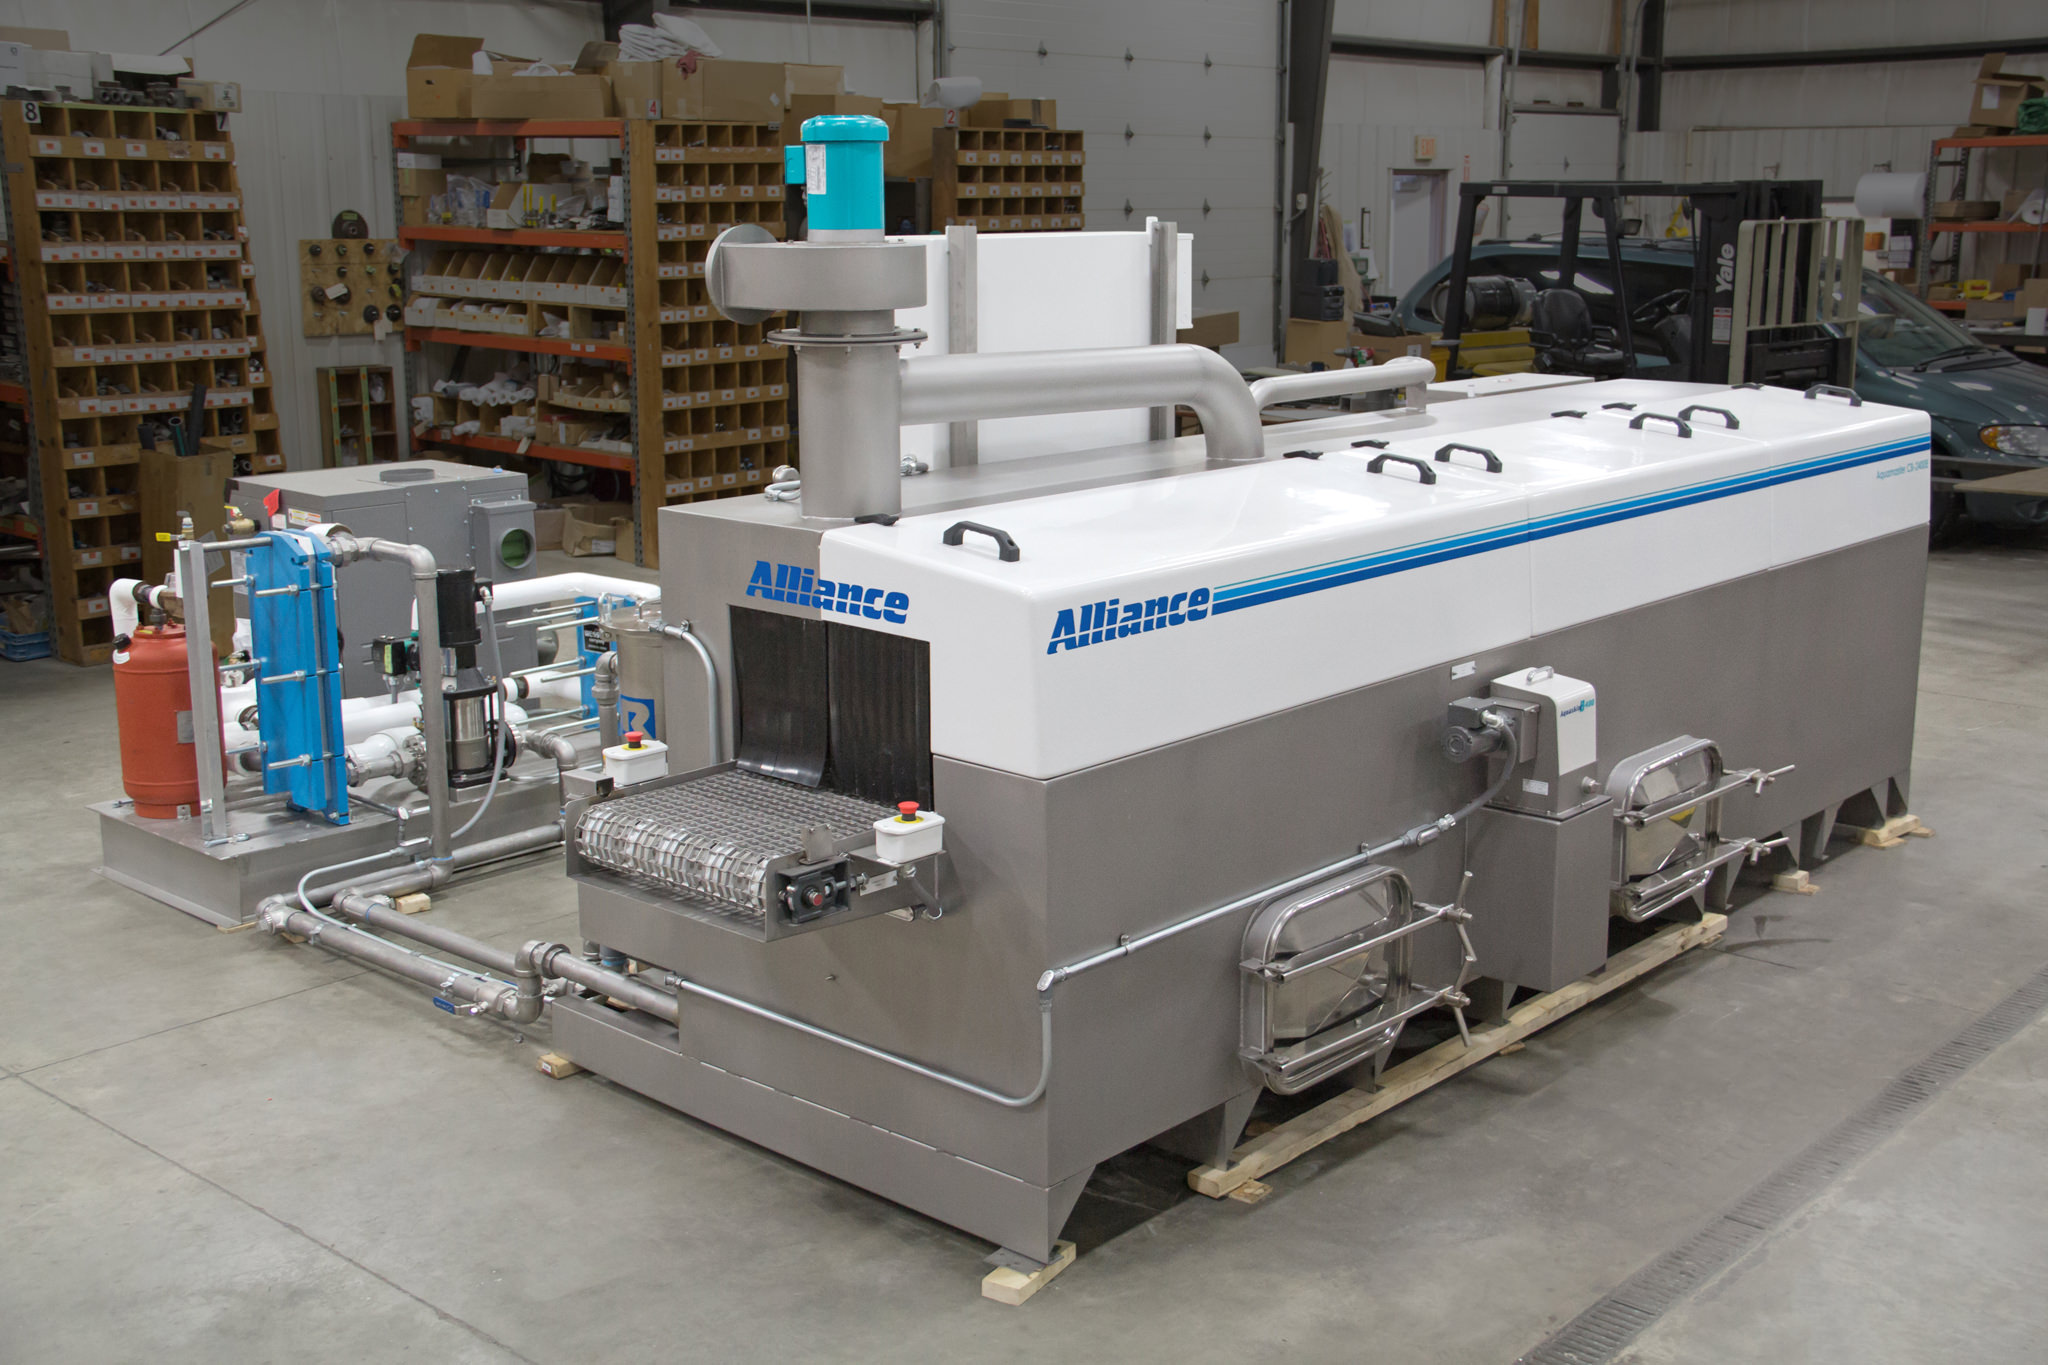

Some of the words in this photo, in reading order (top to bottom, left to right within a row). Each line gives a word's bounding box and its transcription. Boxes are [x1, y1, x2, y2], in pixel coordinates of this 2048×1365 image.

[25, 102, 37, 122] 8
[649, 100, 657, 116] 4
[947, 109, 956, 124] 2
[217, 112, 228, 130] 7
[1715, 243, 1735, 293] Yale
[746, 560, 909, 624] Alliance
[1047, 587, 1210, 655] Alliance
